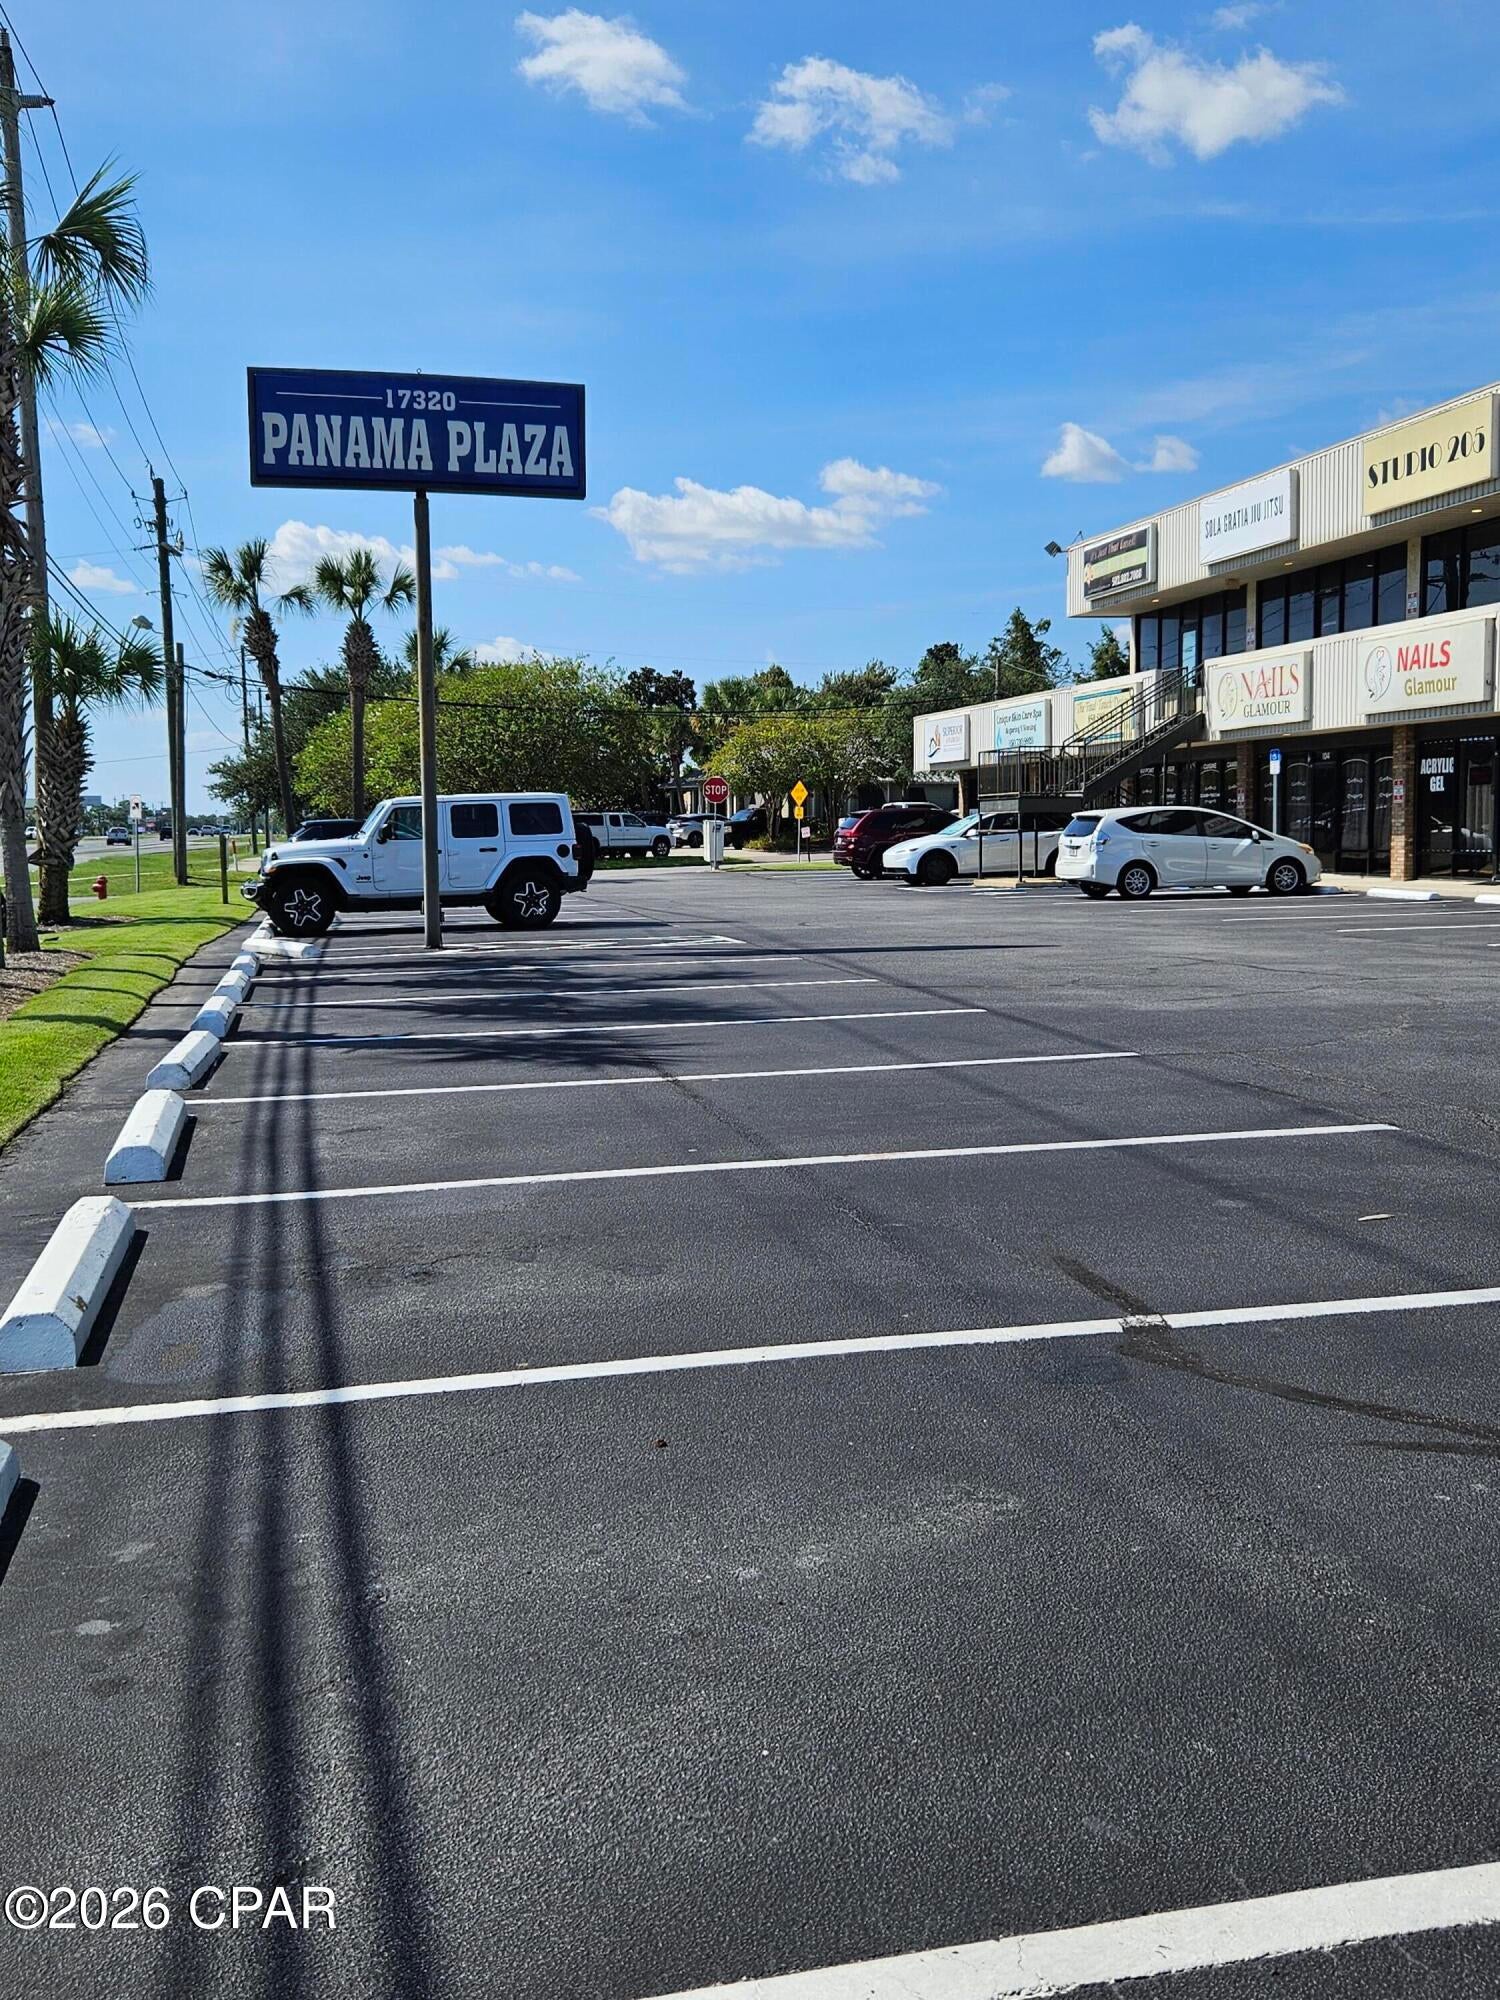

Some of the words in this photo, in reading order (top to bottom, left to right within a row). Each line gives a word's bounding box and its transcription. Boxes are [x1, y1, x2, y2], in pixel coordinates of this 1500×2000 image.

[386, 389, 456, 411] 17320
[261, 411, 433, 471] PANAMA
[447, 420, 574, 477] PLAZA
[1368, 442, 1443, 489] STUDIO
[1447, 426, 1485, 463] 205
[1205, 517, 1221, 539] SOLA
[1223, 506, 1248, 533] GRATIA
[1251, 503, 1261, 525] JIU
[1264, 494, 1284, 520] JITSU
[1397, 640, 1451, 673] NAILS
[1241, 664, 1299, 700] NAILS
[1404, 677, 1457, 697] Glamour
[1243, 700, 1291, 719] GLAMOUR
[1420, 757, 1454, 775] ACRYLIC
[705, 784, 727, 795] STOP
[1430, 776, 1445, 793] GEL
